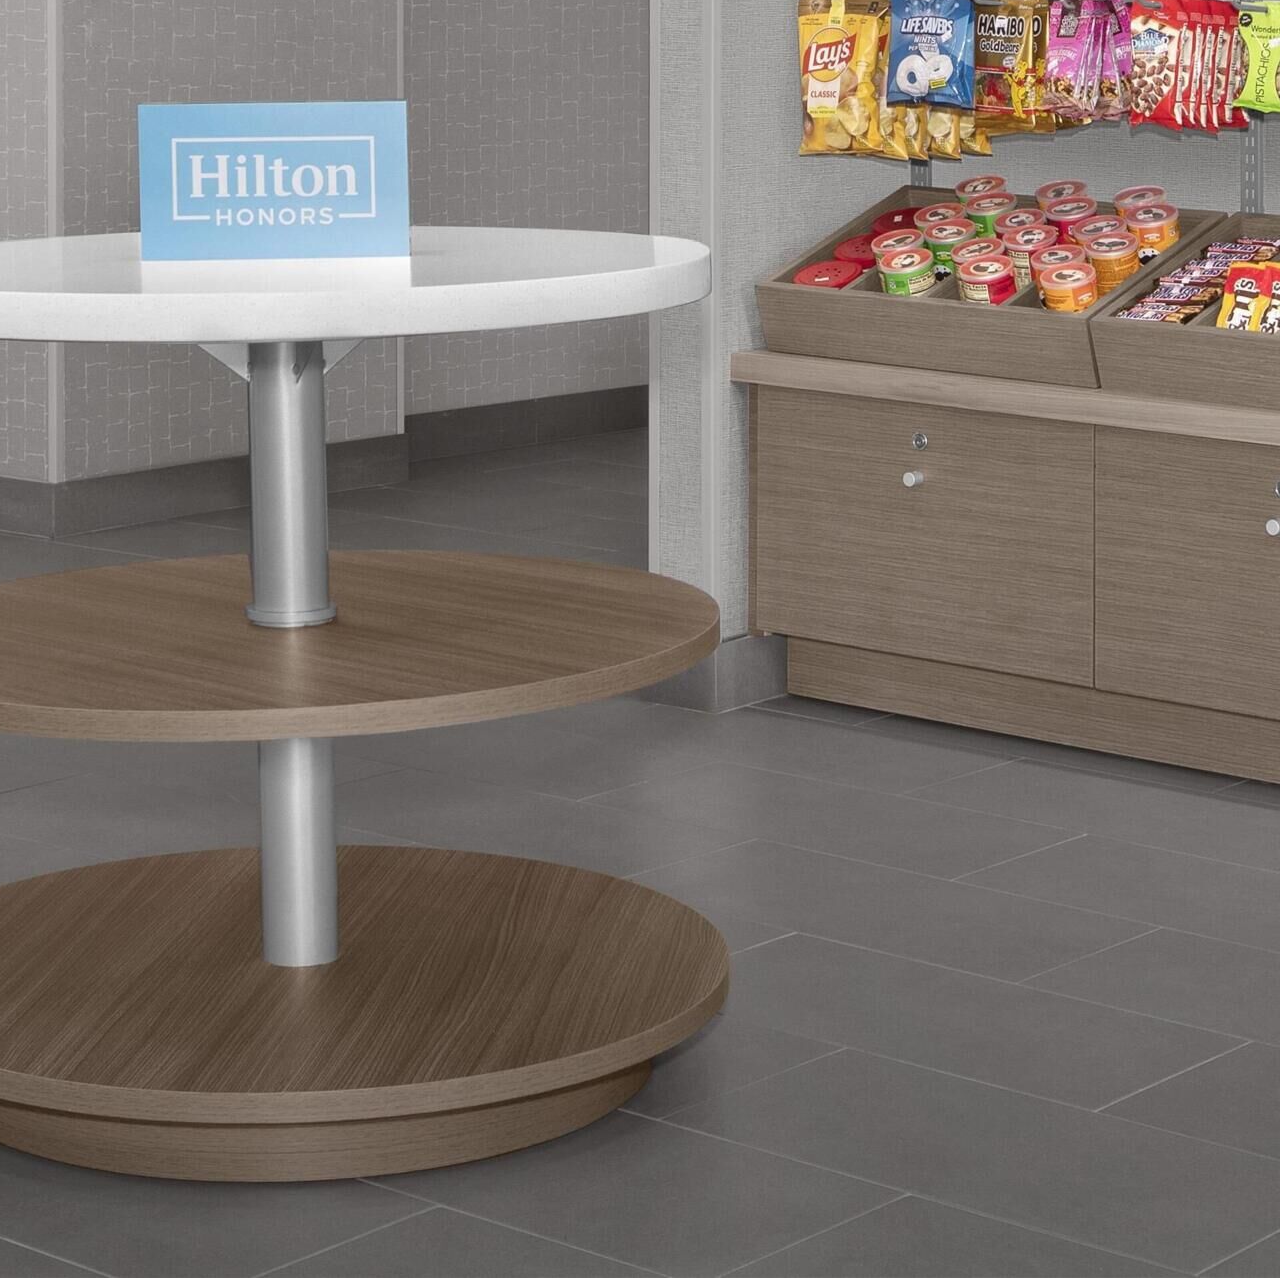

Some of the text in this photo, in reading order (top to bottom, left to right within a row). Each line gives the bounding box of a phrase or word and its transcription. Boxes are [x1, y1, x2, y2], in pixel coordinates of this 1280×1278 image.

[808, 39, 850, 71] Lay's
[980, 40, 1019, 53] Goldbears
[189, 154, 358, 197] Hilton
[216, 208, 333, 226] HONORS
